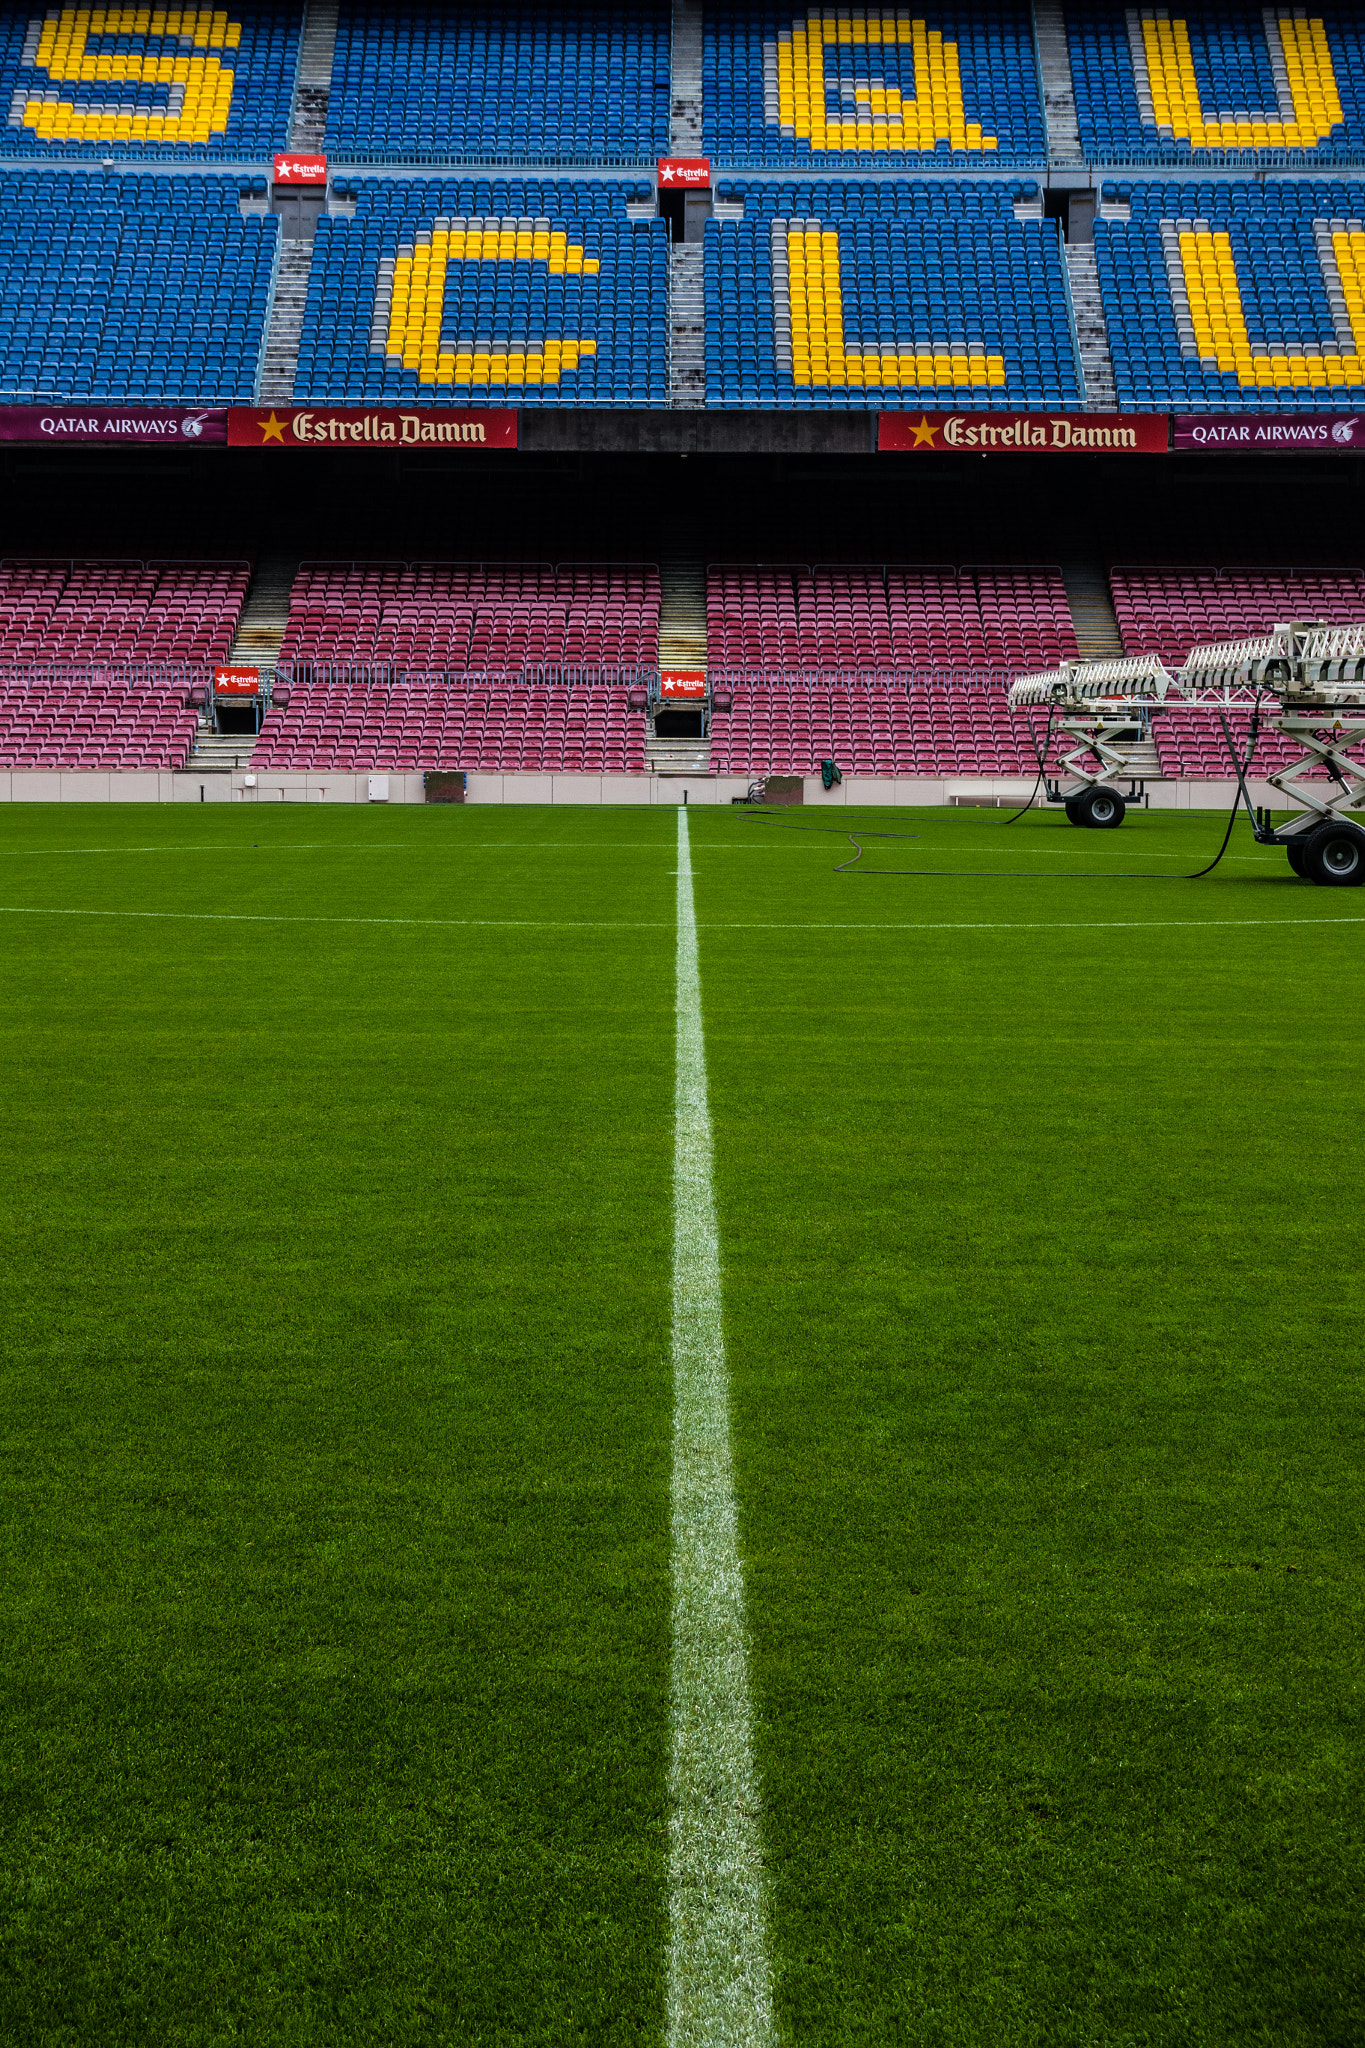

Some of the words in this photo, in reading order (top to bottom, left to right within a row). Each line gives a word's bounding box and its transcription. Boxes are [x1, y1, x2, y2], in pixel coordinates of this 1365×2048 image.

[292, 163, 325, 173] Estrella
[676, 167, 708, 177] Estrella
[40, 418, 100, 435] QATAR
[103, 419, 178, 434] AIRWAYS
[292, 411, 397, 442] Estrella
[399, 415, 487, 444] Damm
[943, 416, 1048, 447] Estrella
[1050, 420, 1137, 448] Damm
[1192, 426, 1251, 444] QATAR
[1254, 425, 1328, 440] AIRWAYS
[230, 675, 258, 684] Estrella
[676, 679, 704, 688] Estrella
